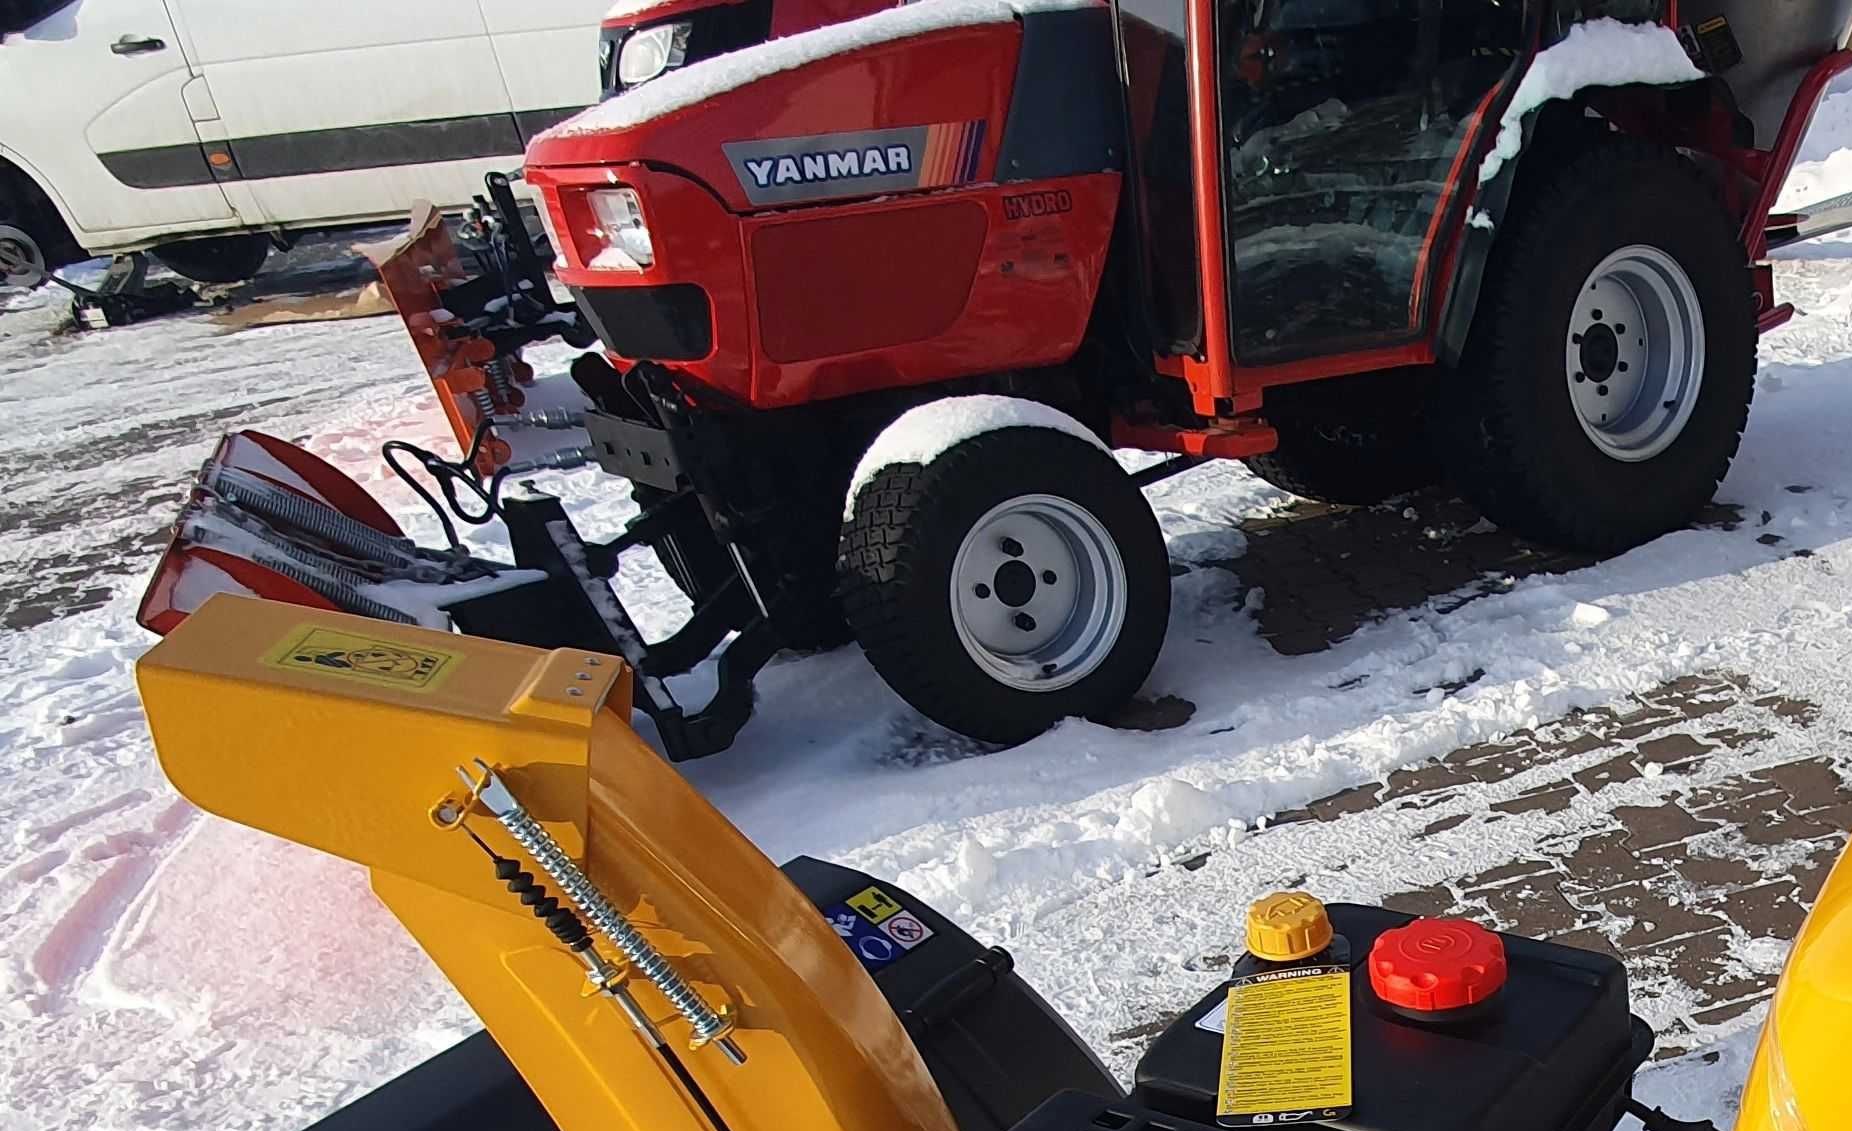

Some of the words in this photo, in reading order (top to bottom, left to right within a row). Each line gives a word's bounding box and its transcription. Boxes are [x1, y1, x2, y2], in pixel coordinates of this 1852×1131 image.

[745, 145, 912, 187] YANMAR
[1003, 190, 1072, 219] HYDRO
[1256, 968, 1322, 983] WARNING
